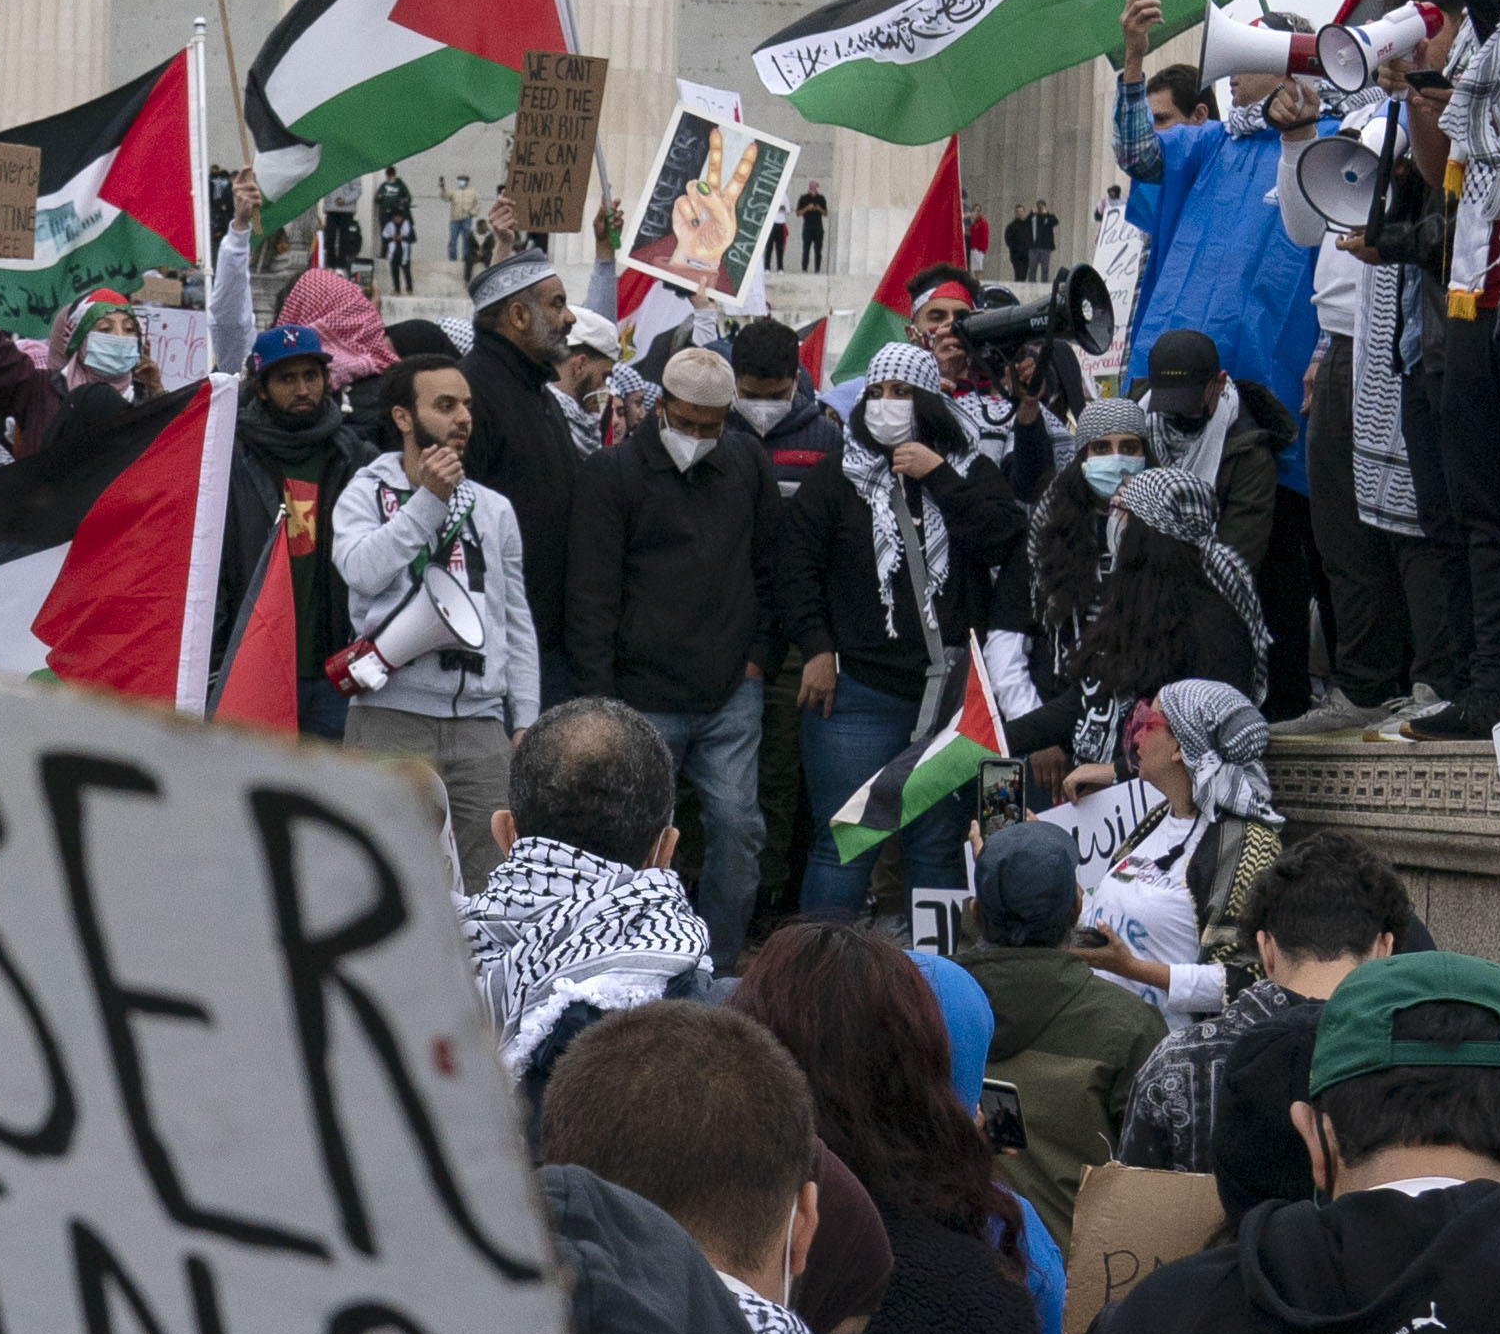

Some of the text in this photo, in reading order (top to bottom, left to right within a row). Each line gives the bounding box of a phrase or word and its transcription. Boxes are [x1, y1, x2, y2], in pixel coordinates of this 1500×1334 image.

[527, 53, 594, 83] WE CANT
[521, 87, 592, 113] FEED THE
[516, 114, 592, 141] POOR BUT
[515, 143, 578, 165] WE CAN
[512, 171, 572, 193] FUND A
[528, 198, 565, 223] WAR
[727, 148, 789, 267] PALESTINE
